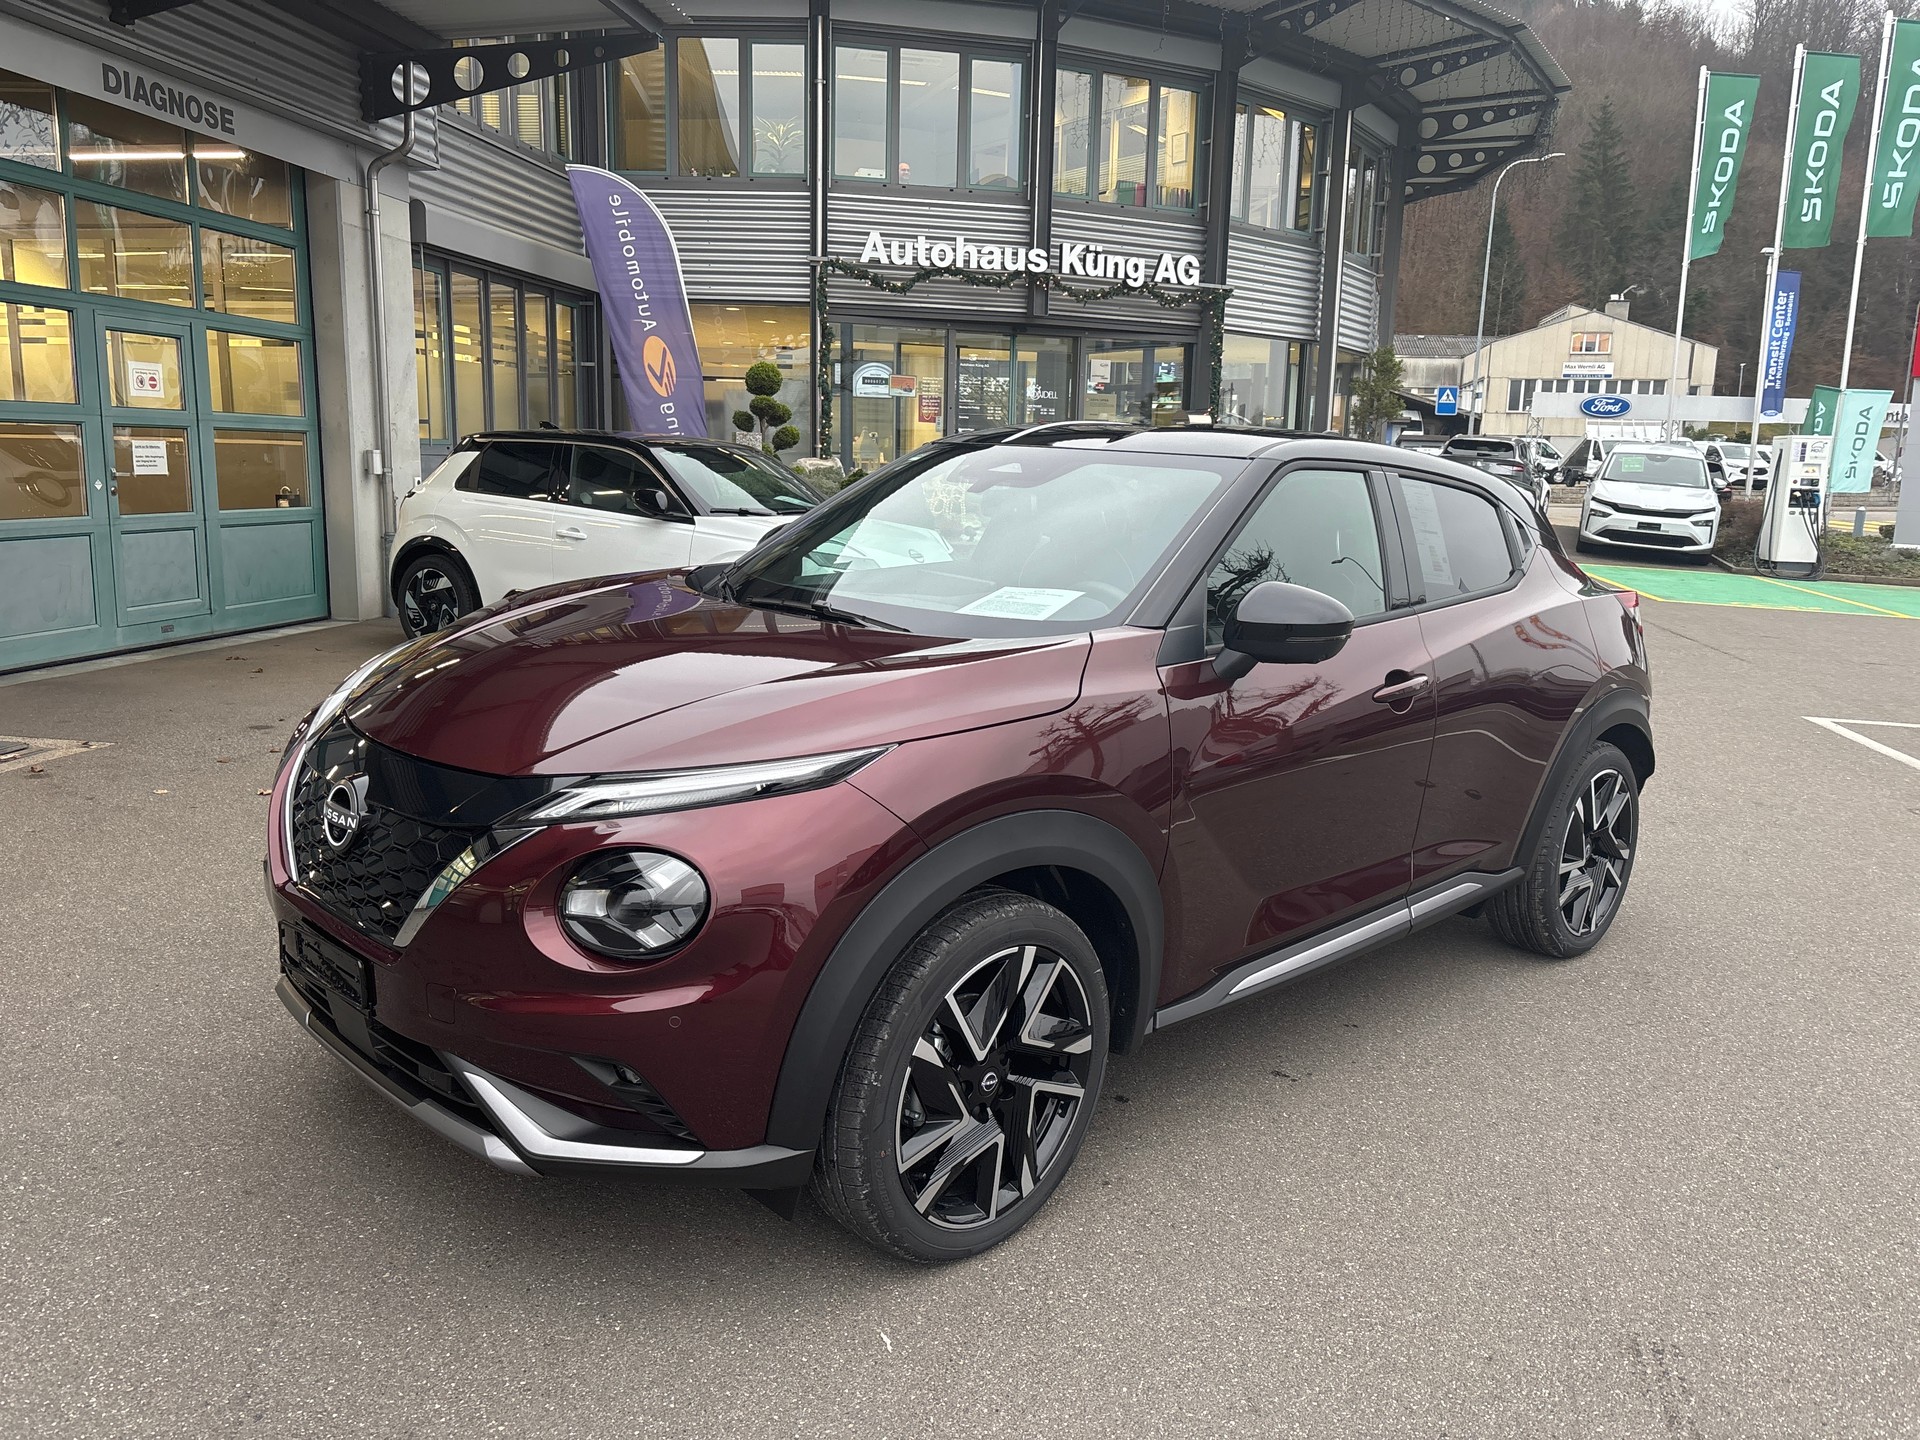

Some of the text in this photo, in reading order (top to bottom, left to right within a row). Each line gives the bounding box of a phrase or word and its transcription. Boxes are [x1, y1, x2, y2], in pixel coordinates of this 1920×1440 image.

[102, 62, 235, 135] DIAGNOSE
[859, 230, 1201, 288] Autohaus Küng AG
[1764, 290, 1788, 389] Transit Center
[326, 808, 357, 830] SSAN
